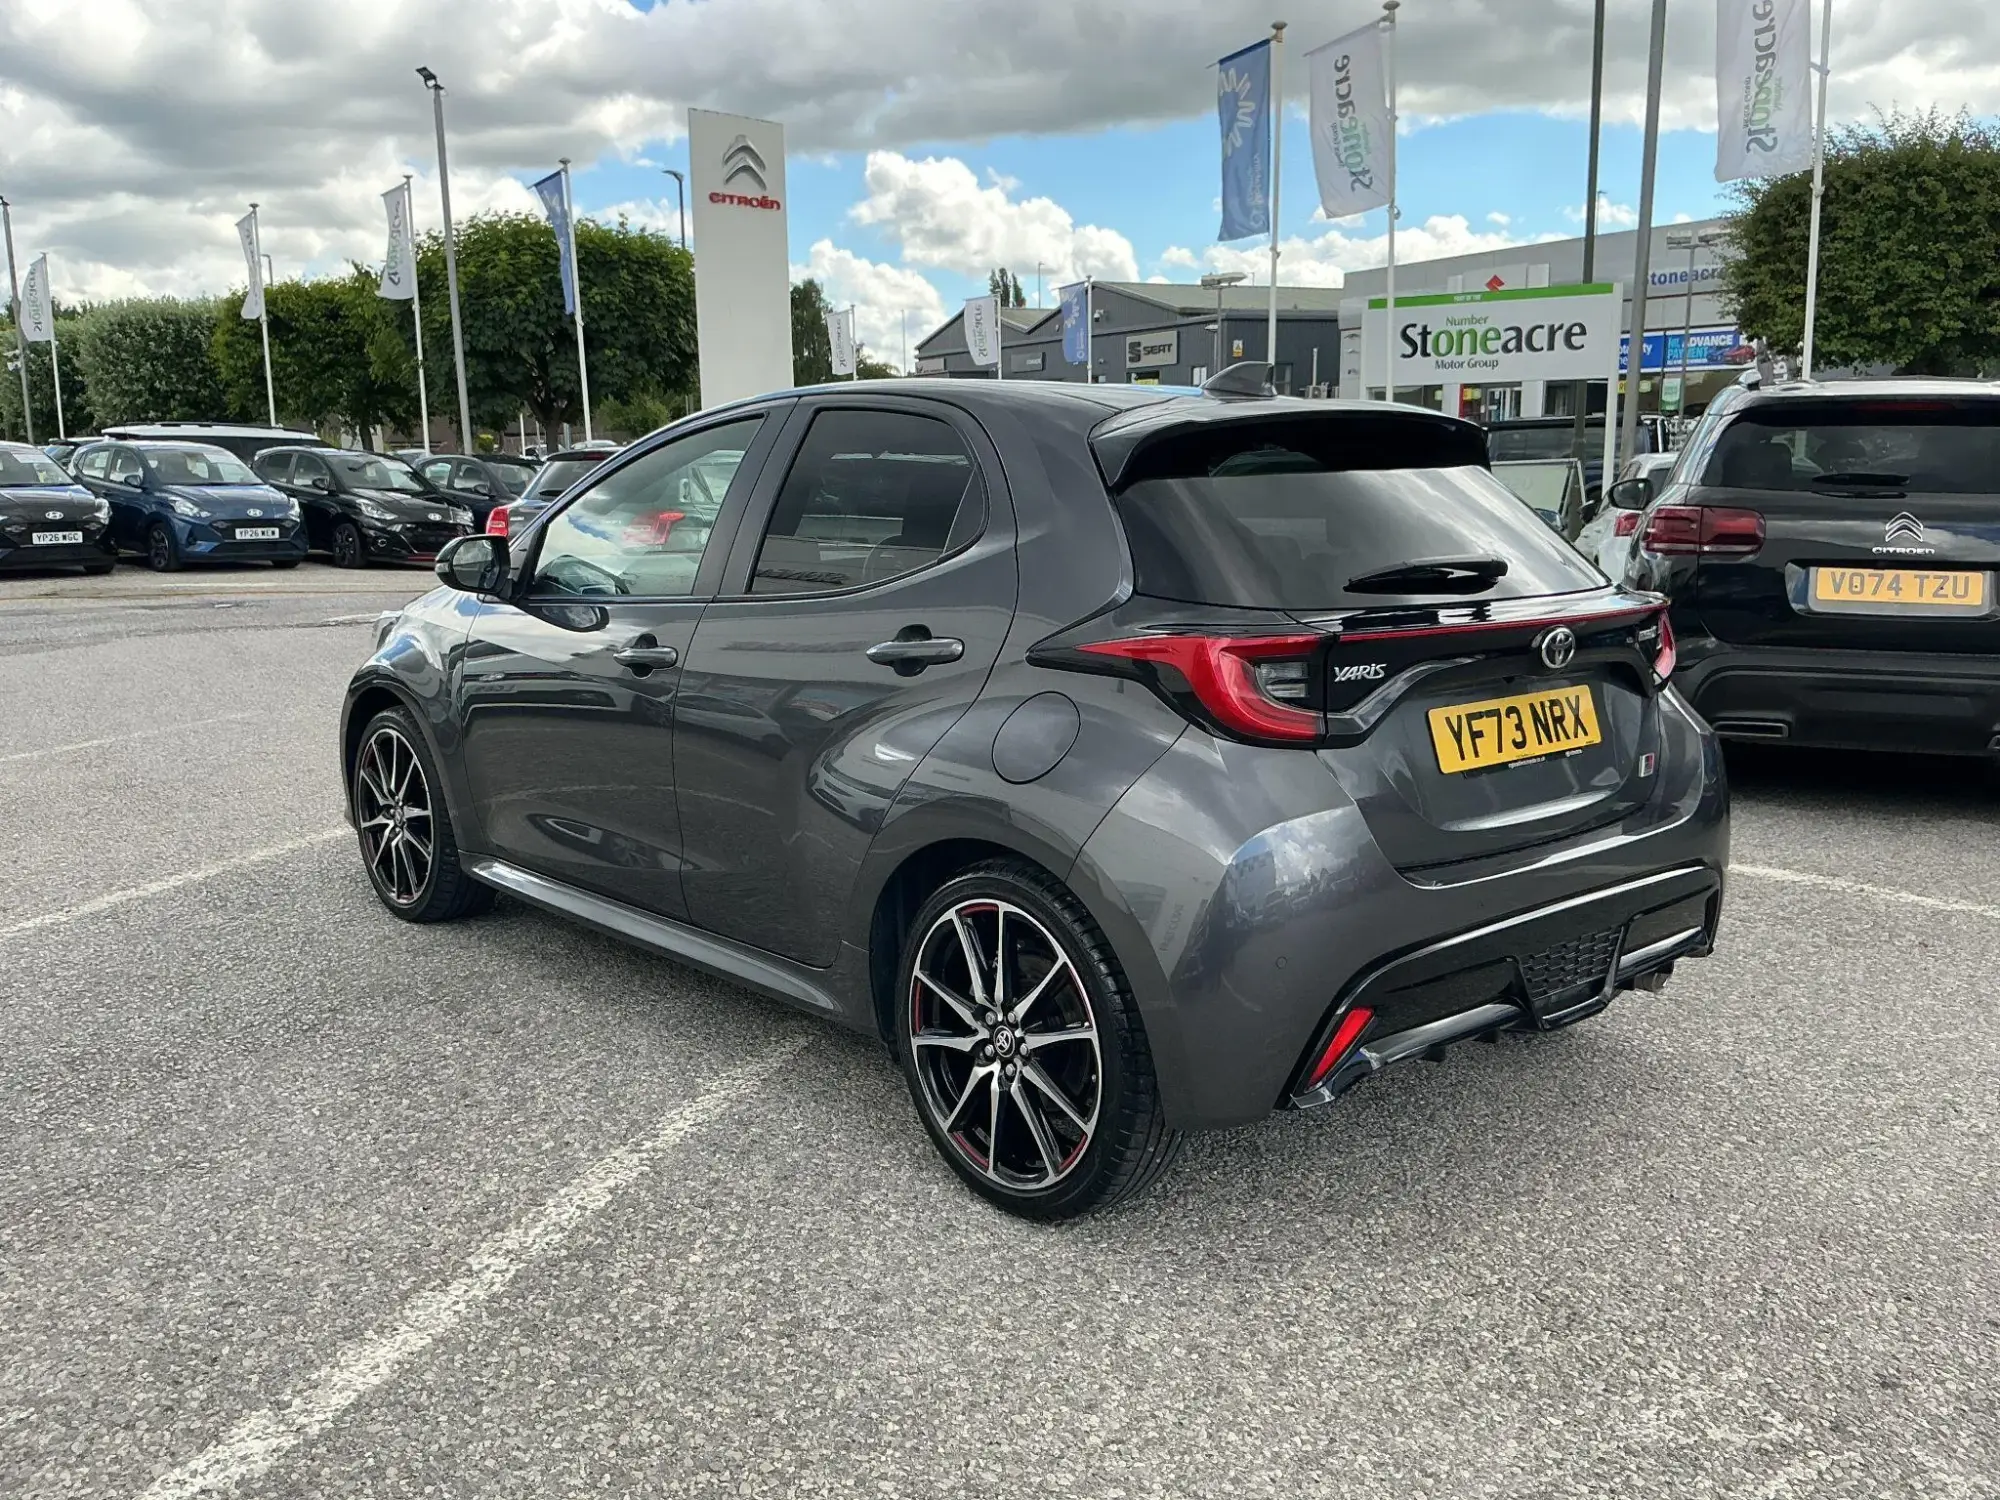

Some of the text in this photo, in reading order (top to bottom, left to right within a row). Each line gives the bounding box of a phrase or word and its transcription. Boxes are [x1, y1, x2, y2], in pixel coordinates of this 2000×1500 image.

[1446, 314, 1489, 327] Number
[1143, 343, 1173, 355] SEAT
[1400, 320, 1587, 359] Stoneacre
[1435, 357, 1499, 371] Motor Group
[1913, 574, 1970, 600] TZU
[1445, 694, 1589, 761] YF73 NRX
